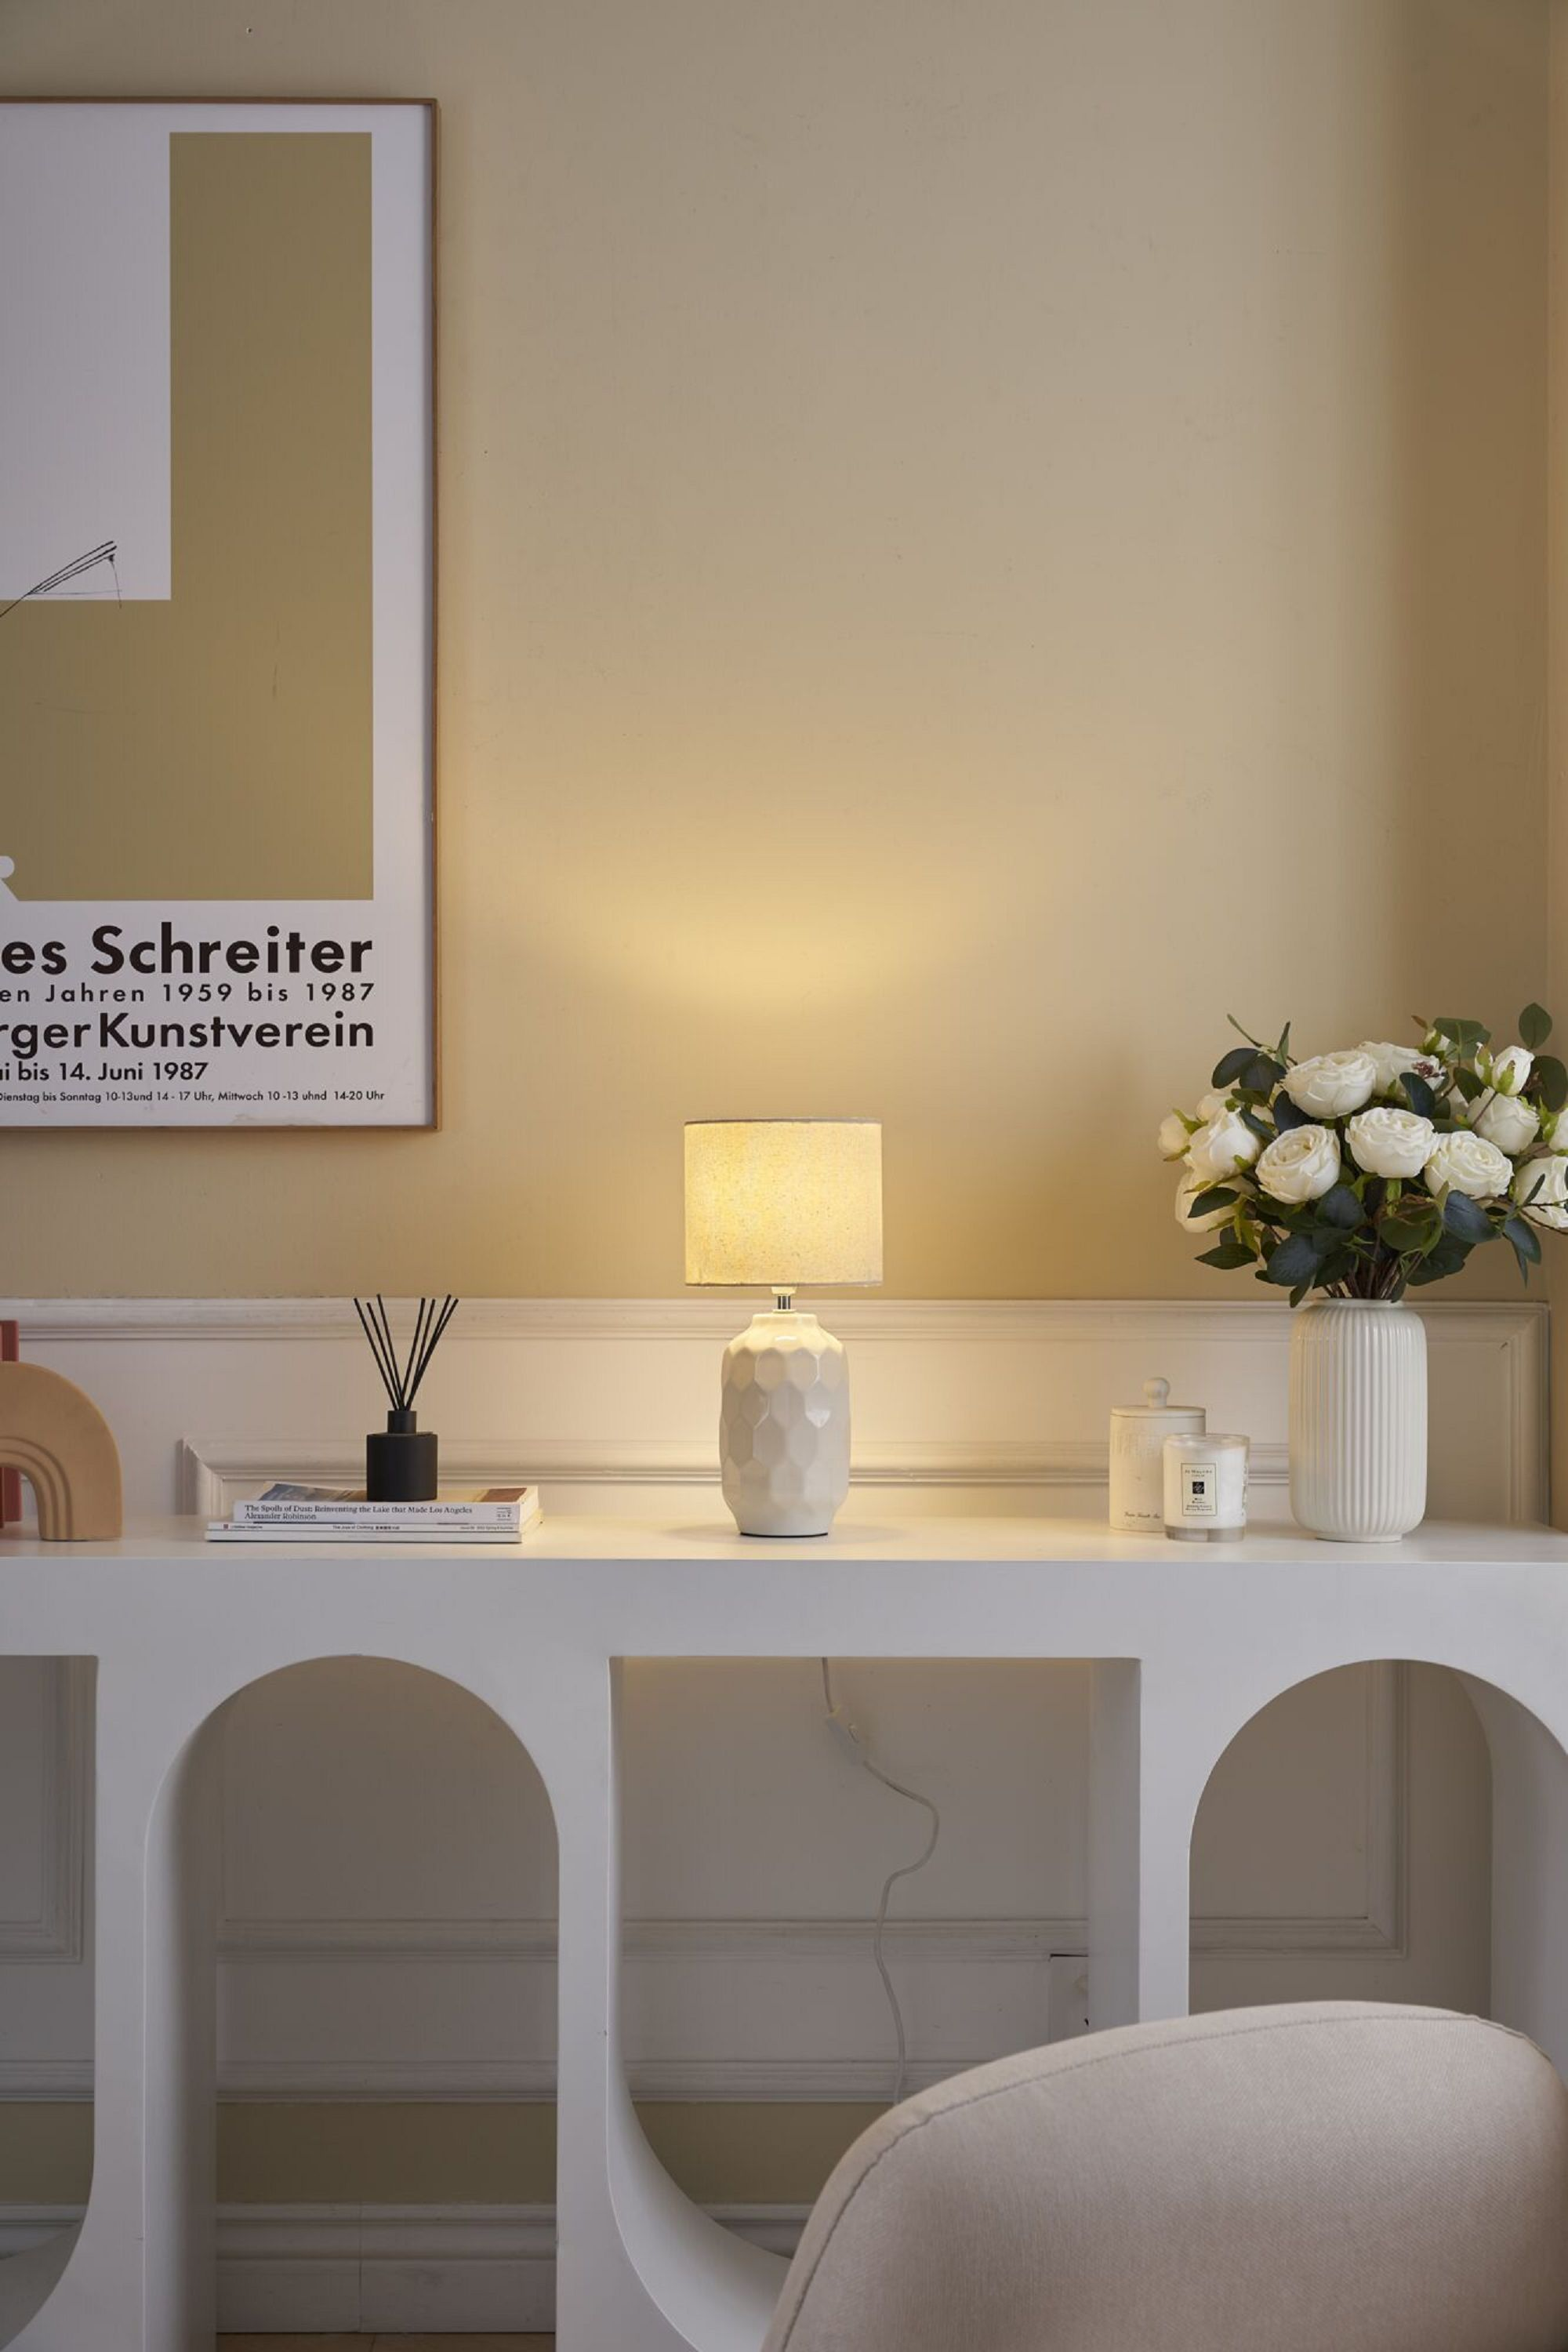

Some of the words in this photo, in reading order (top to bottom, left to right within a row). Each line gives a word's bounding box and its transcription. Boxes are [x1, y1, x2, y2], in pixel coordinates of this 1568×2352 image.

[91, 921, 373, 975] Schreiter
[45, 982, 143, 1002] Jahren
[163, 983, 233, 1002] 1959
[249, 982, 288, 1002] bis
[307, 982, 375, 1002] 1987
[100, 1011, 373, 1048] Kunstverein
[18, 1061, 49, 1080] bis
[60, 1062, 90, 1080] 14.
[98, 1062, 143, 1080] Juni
[154, 1062, 209, 1080] 1987
[42, 1091, 56, 1102] bis
[60, 1091, 101, 1104] Sonntag
[194, 1091, 215, 1102] Uhr,
[218, 1090, 263, 1102] Mittwoch
[334, 1091, 363, 1101] 14-20
[366, 1090, 385, 1101] Uhr
[260, 1505, 282, 1514] Spoils
[315, 1505, 358, 1514] Reinventing
[445, 1506, 472, 1515] Angeles
